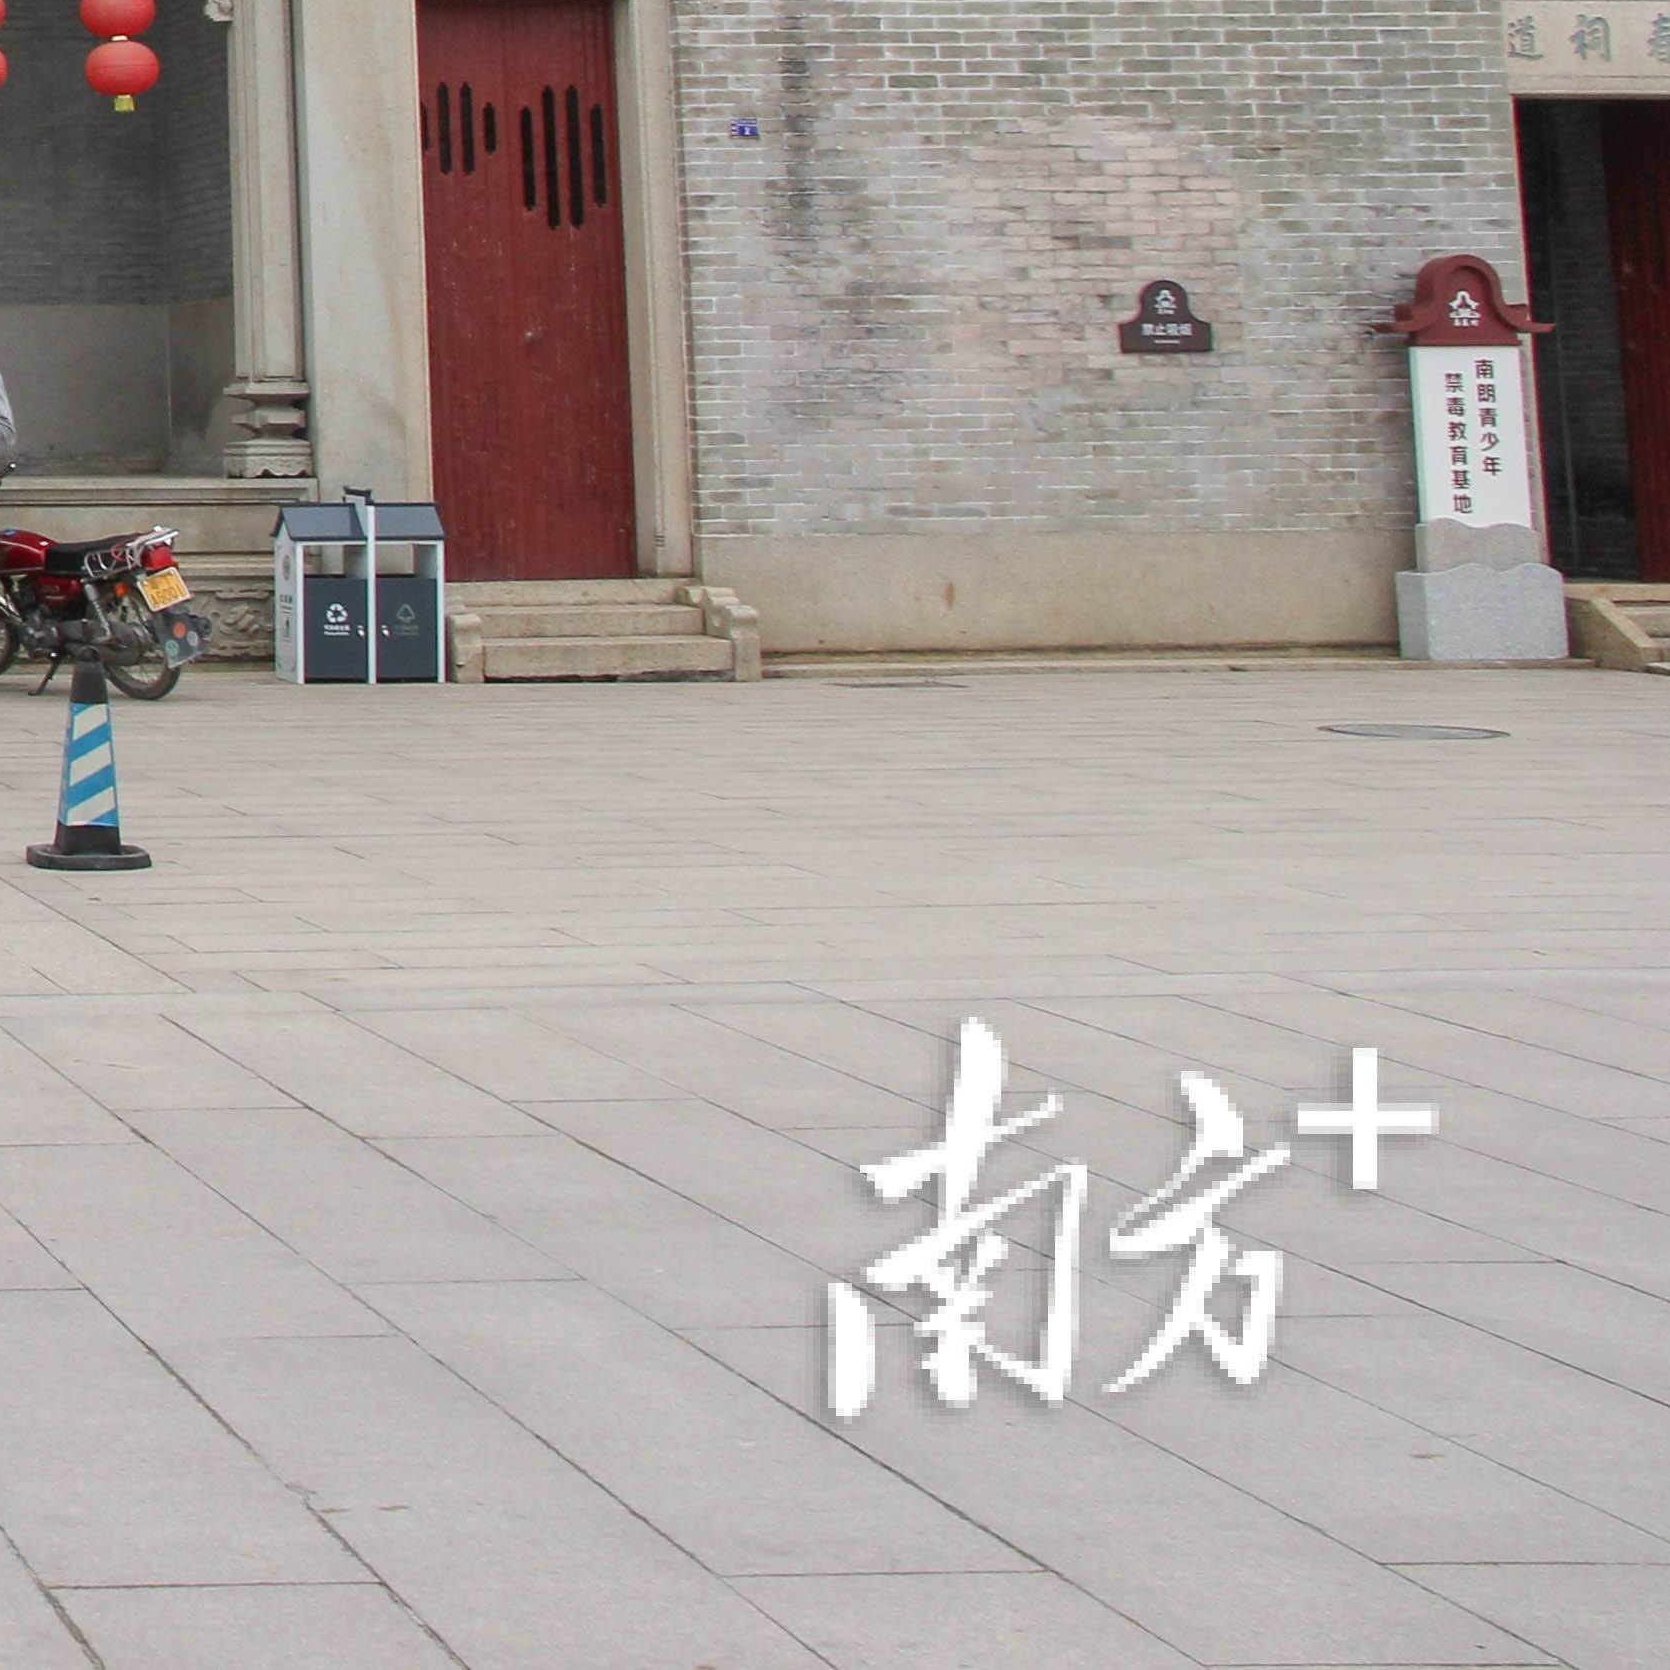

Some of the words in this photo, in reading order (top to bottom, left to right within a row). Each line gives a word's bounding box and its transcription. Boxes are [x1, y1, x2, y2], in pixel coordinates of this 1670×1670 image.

[1445, 373, 1473, 514] 禁毒教育基地
[1474, 359, 1502, 476] 南朗青少年
